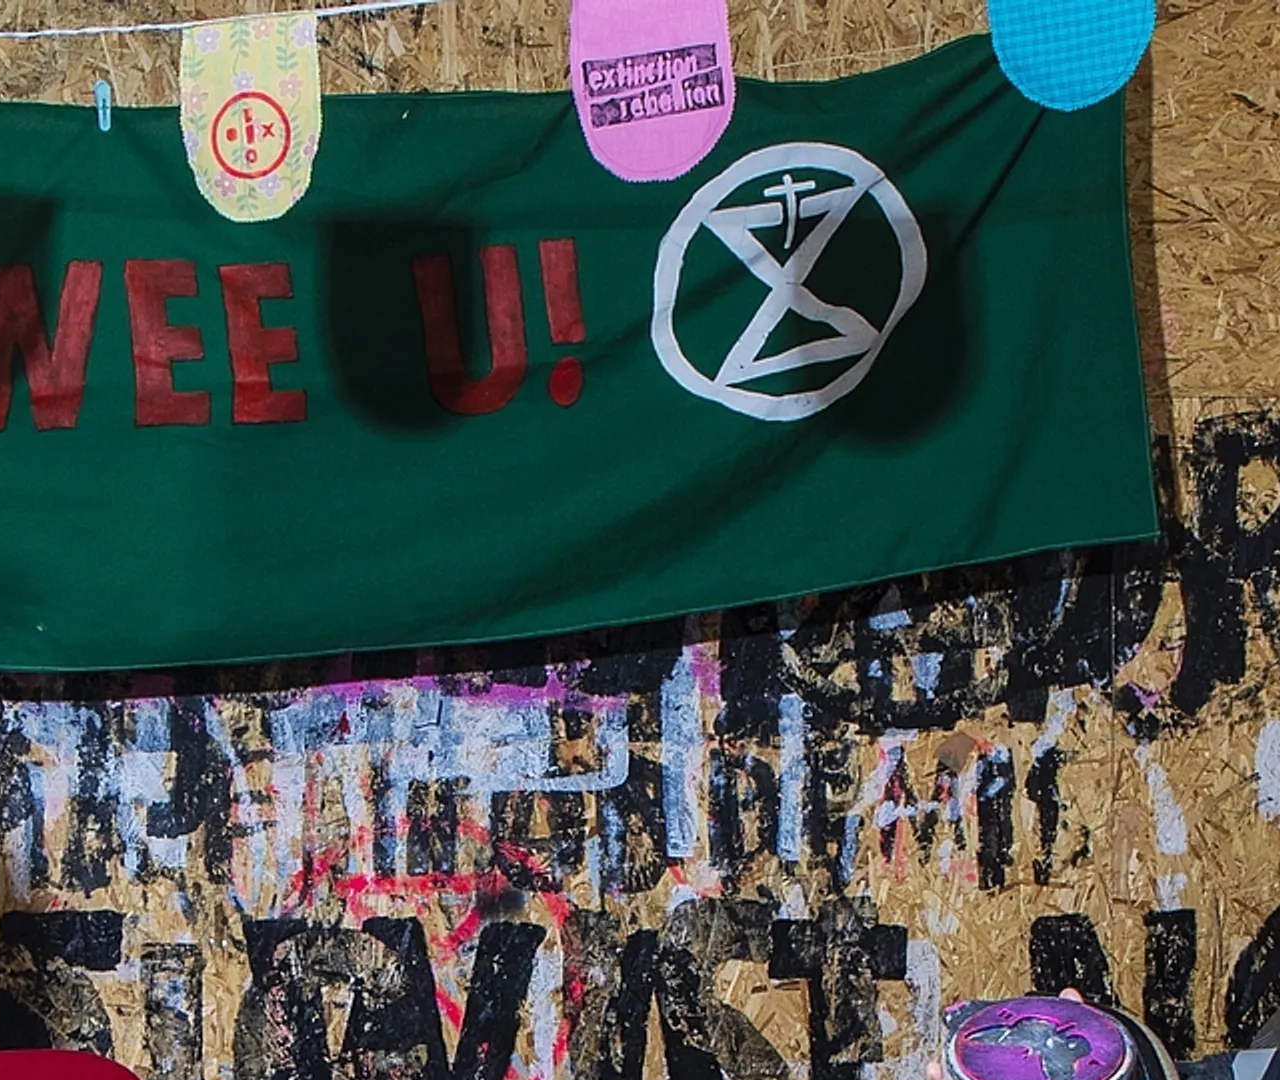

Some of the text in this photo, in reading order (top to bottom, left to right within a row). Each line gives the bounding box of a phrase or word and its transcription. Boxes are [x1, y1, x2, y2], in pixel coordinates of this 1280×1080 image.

[588, 51, 698, 91] extinction
[620, 78, 720, 117] rebellion
[412, 238, 586, 416] U!
